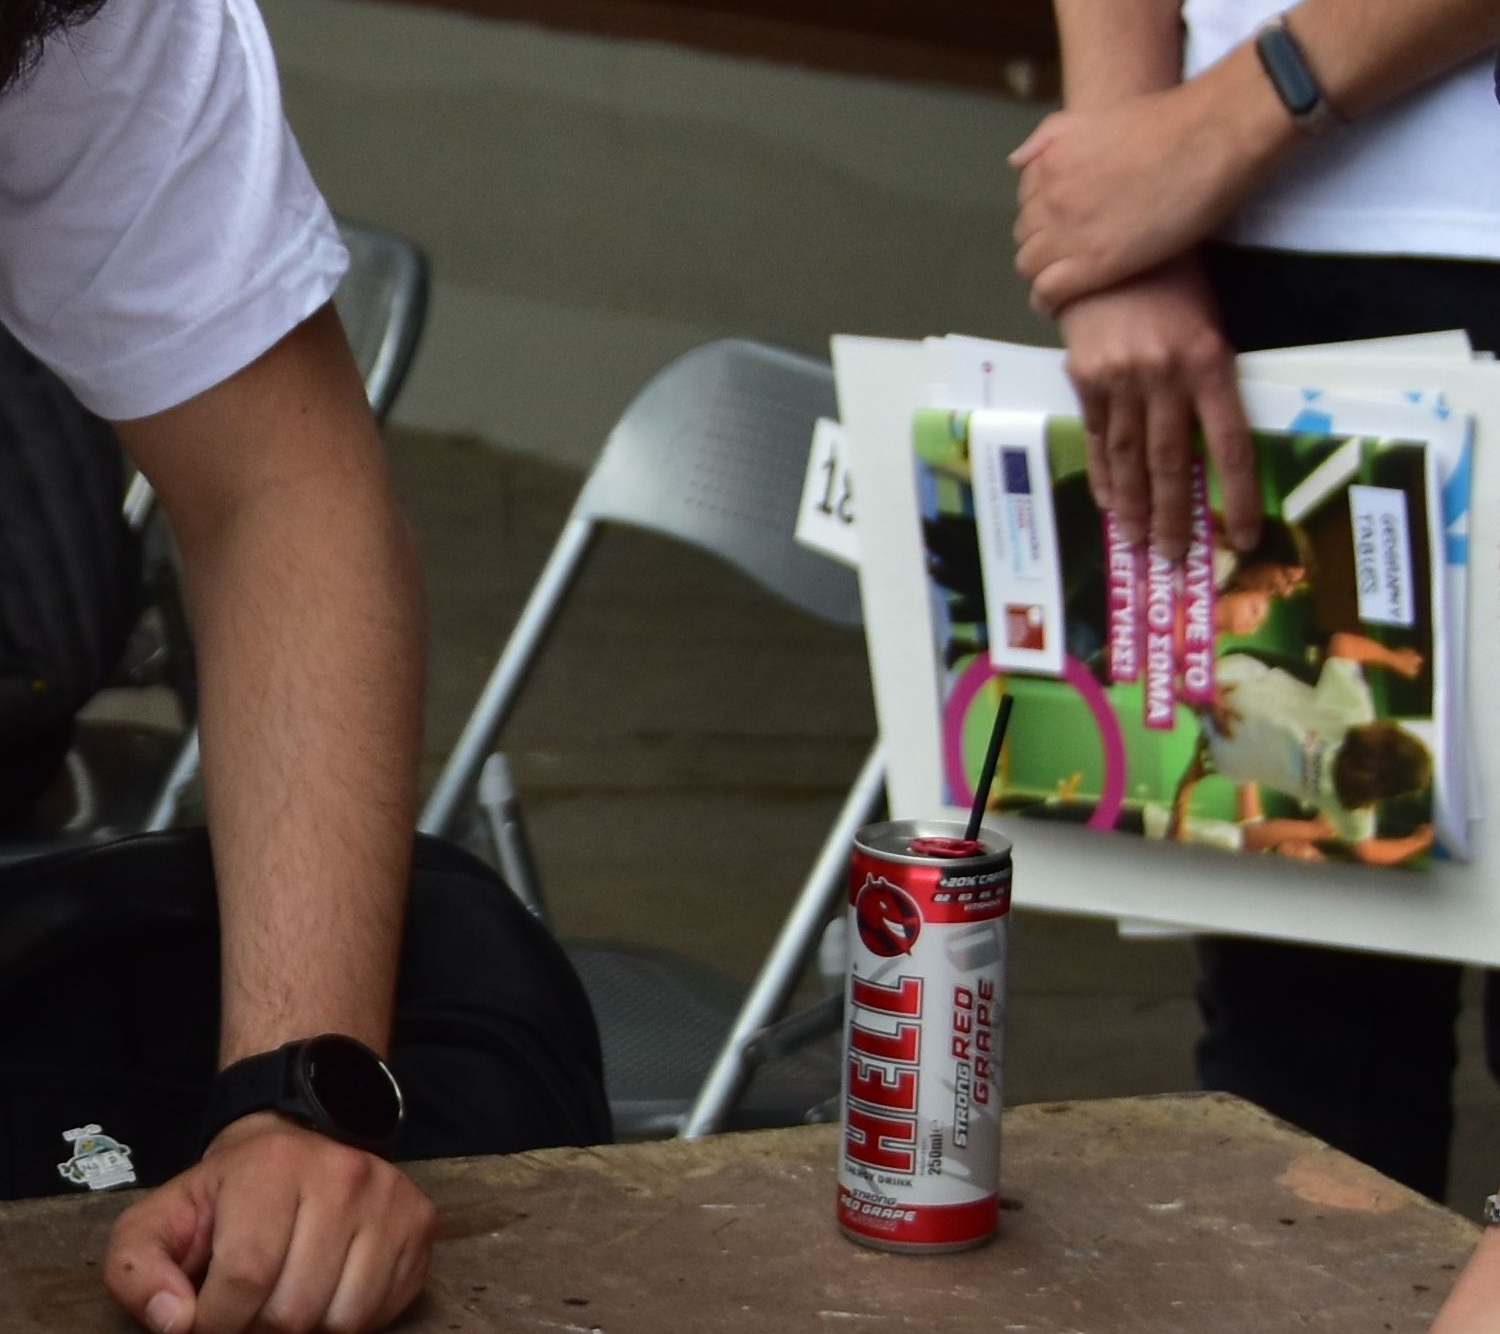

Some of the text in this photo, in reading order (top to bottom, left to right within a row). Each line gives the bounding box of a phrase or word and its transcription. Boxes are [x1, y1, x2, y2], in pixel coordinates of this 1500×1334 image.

[1148, 633, 1173, 719] ΣΩΜΑ
[1185, 648, 1210, 688] ΤΟ
[973, 978, 995, 1105] GRAPE
[845, 974, 924, 1175] HELL
[951, 985, 974, 1149] STRONG RED
[928, 1133, 944, 1176] 250ml
[852, 1188, 898, 1206] STRONG
[877, 1173, 914, 1188] DRINK
[861, 1203, 917, 1222] GRAPE
